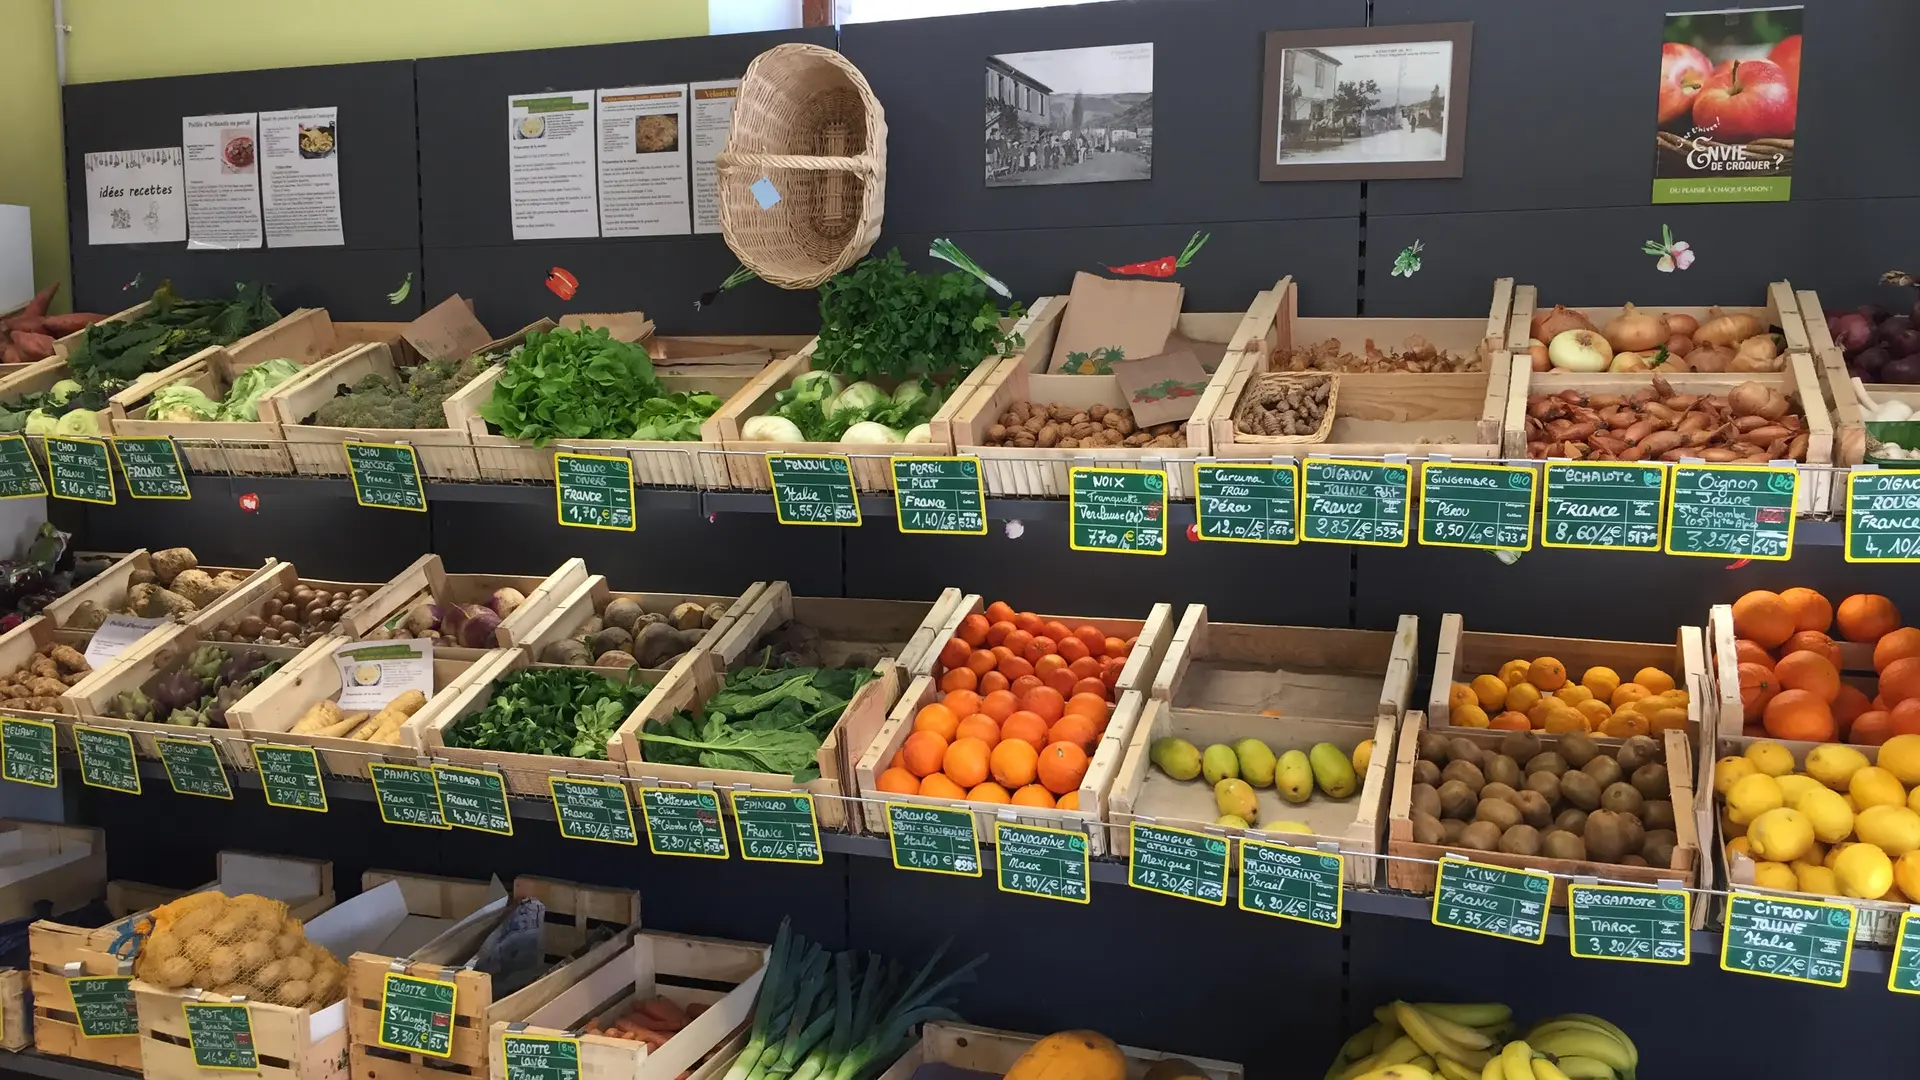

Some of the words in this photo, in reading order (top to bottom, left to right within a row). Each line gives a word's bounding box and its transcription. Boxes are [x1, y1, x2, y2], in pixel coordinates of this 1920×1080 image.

[1711, 161, 1724, 171] DE
[1726, 160, 1770, 171] CROQUER
[99, 186, 124, 199] idées
[129, 184, 173, 197] recettes
[1682, 186, 1705, 194] PLAISIR
[1713, 185, 1742, 194] CHAQUE
[1743, 185, 1768, 193] SAISON
[57, 442, 77, 452] CHOU
[124, 443, 144, 452] CHOU
[358, 447, 379, 457] CHOU
[1093, 476, 1125, 487] NOIX
[1698, 473, 1758, 498] Oignon
[1877, 476, 1920, 491] OIGNO
[784, 487, 820, 501] Italie
[1087, 492, 1141, 507] Franquette
[1696, 492, 1751, 507] Jaune
[384, 770, 420, 783] PANAIS
[904, 836, 938, 850] Italie
[1141, 853, 1191, 872] Mexique
[1249, 874, 1282, 892] Israël
[1591, 919, 1640, 934] MAROC
[1744, 931, 1797, 952] Italie
